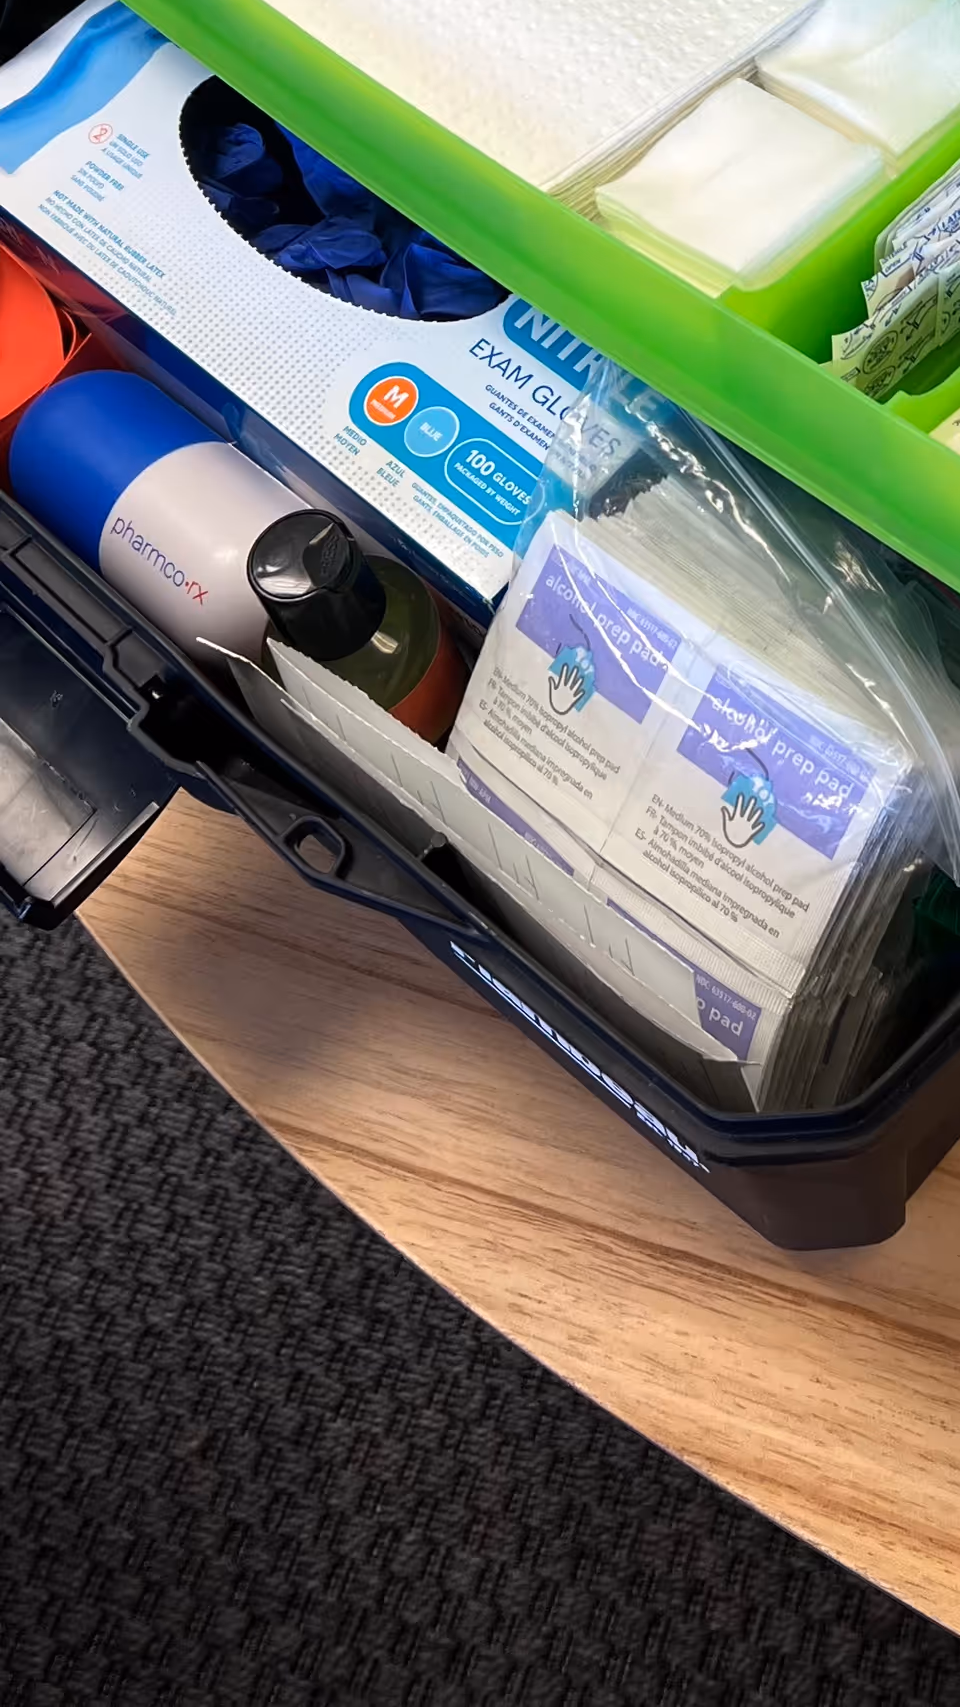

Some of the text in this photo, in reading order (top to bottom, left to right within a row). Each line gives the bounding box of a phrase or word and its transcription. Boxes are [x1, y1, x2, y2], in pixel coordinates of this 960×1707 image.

[86, 161, 125, 191] POWDER FREE
[53, 190, 68, 201] NOT
[66, 199, 84, 215] MADE
[83, 212, 99, 227] WITH
[98, 224, 124, 248] NATURAL
[146, 262, 165, 278] LATEX
[469, 338, 533, 390] EXAM
[383, 384, 409, 409] M
[485, 384, 518, 411] GUANTES
[516, 406, 529, 419] DE
[489, 402, 513, 424] GANTS
[334, 433, 360, 456] MOYEN
[343, 426, 368, 446] MEDIO
[419, 421, 443, 442] BLUE
[376, 468, 400, 488] BLEUE
[385, 460, 406, 478] AZUL
[464, 449, 532, 505] 100 GLOVES
[453, 462, 521, 516] PACKAGED BY WEIGHT
[593, 613, 632, 645] prep
[628, 638, 664, 666] pad
[512, 714, 533, 737] moyen
[567, 728, 590, 751] alcohol
[589, 746, 606, 764] prep
[772, 739, 815, 775] prep
[814, 770, 856, 799] pad
[583, 787, 594, 800] en
[658, 829, 671, 843] 70
[678, 843, 705, 870] moyen
[659, 814, 688, 845] Tampon
[714, 856, 744, 886] d'alcool
[664, 803, 695, 832] Medium
[694, 825, 712, 843] 70%
[745, 862, 774, 888] alcohol
[772, 883, 793, 903] prep
[791, 896, 811, 913] pad
[642, 849, 739, 923] alcohol al 70 %
[648, 838, 691, 876] Almohadilla
[690, 870, 723, 898] mediana
[721, 890, 769, 933] impregnada
[767, 925, 781, 939] en
[709, 1006, 744, 1037] pad
